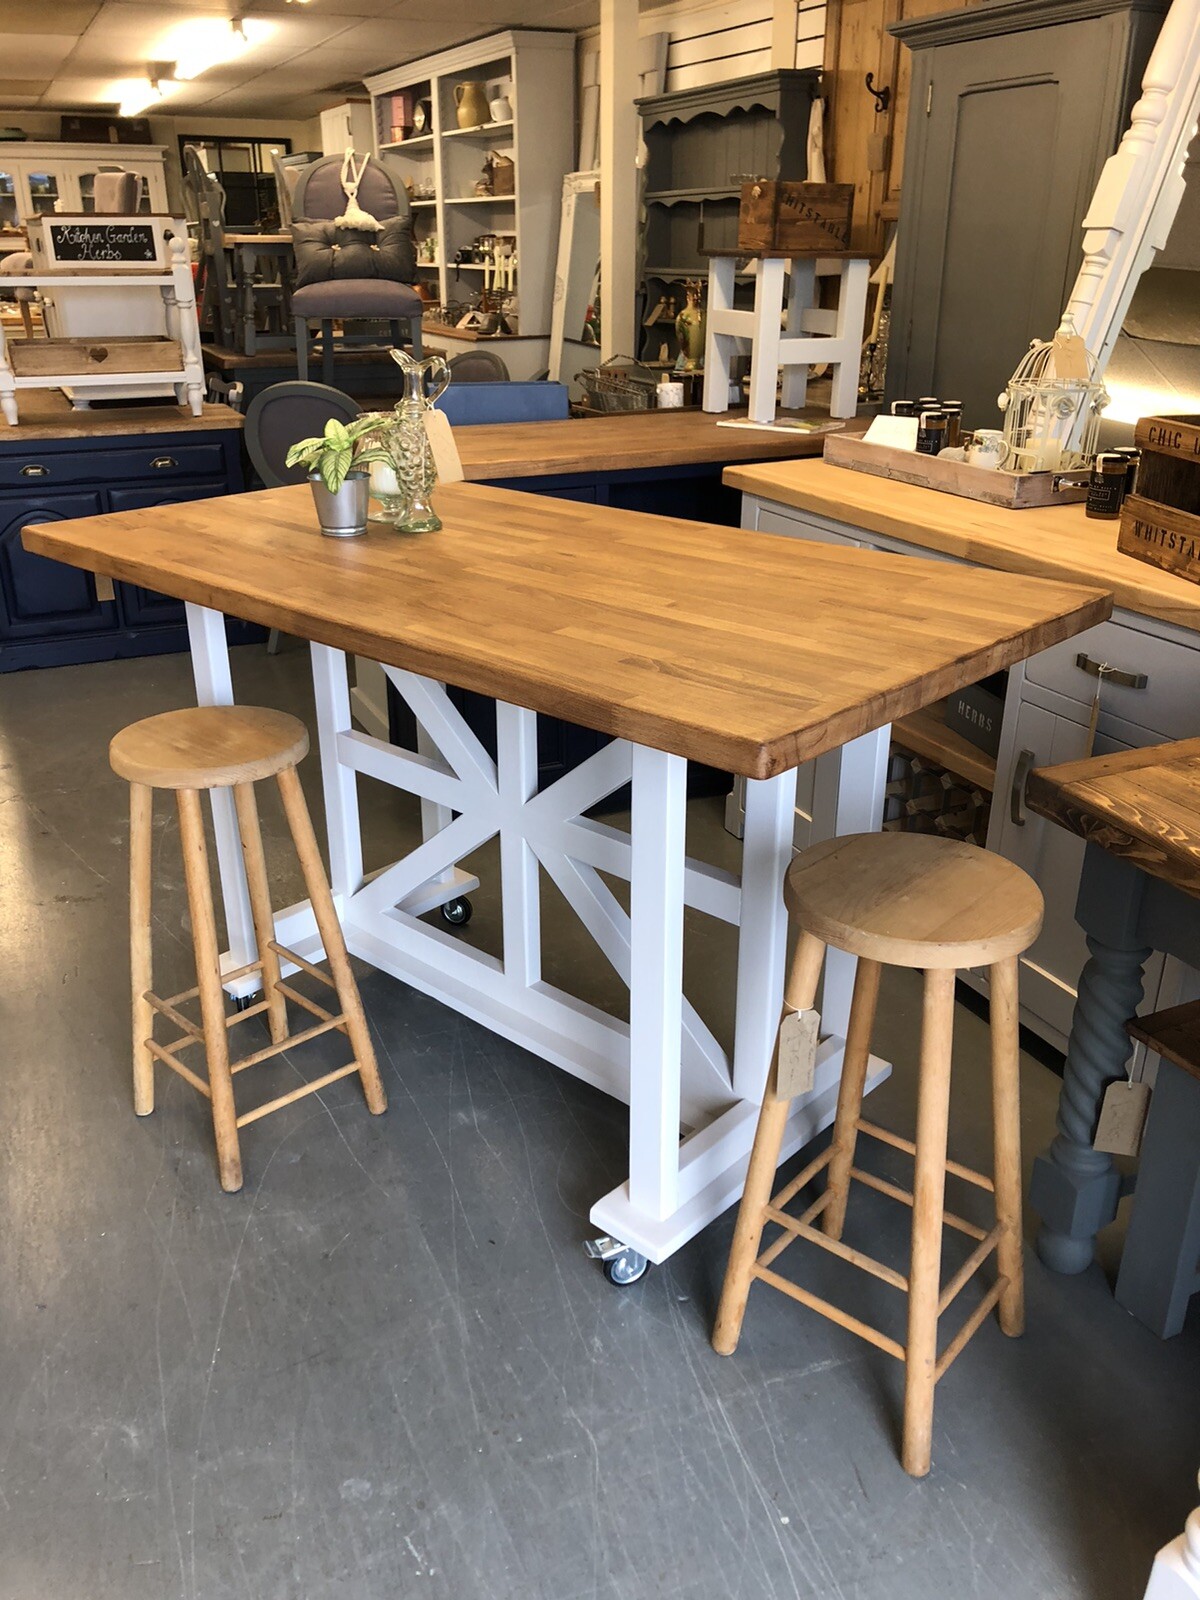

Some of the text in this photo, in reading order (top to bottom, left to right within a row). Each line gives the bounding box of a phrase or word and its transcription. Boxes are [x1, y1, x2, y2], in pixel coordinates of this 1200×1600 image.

[57, 225, 148, 244] Kitchen Garden
[78, 243, 122, 260] Herbs
[1148, 426, 1182, 449] CHIC
[1134, 519, 1200, 560] WHITSTA
[957, 700, 993, 732] HERBS
